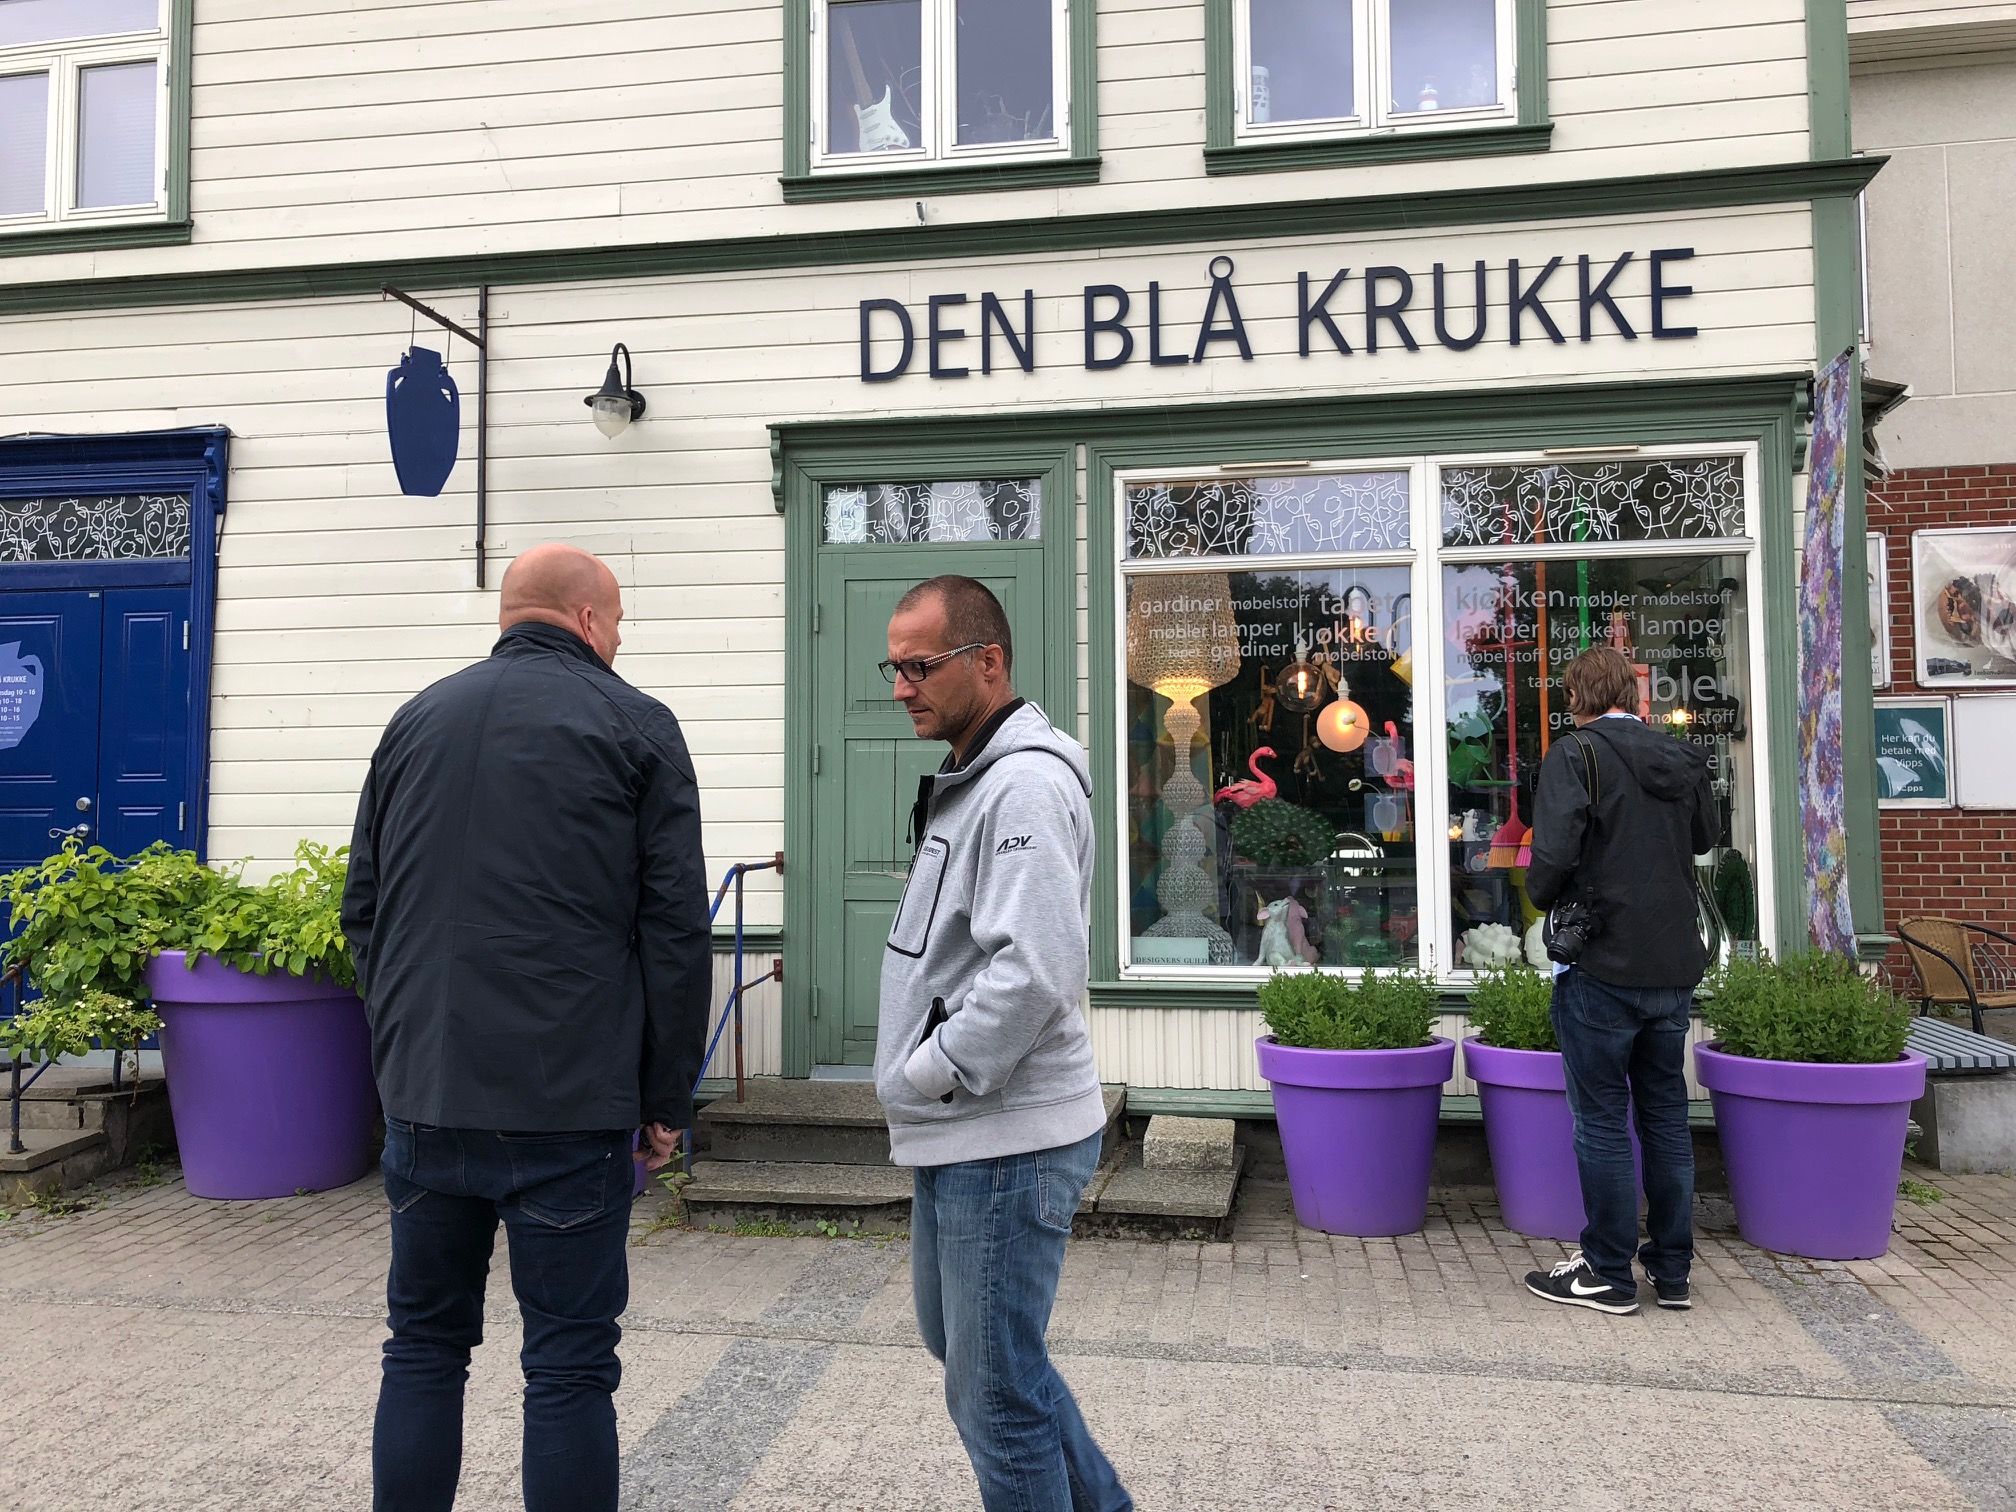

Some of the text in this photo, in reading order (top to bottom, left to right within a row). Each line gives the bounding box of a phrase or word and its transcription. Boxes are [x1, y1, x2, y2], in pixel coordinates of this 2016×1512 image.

[860, 247, 1698, 383] DEN BLÅ KRUKKE
[1140, 595, 1223, 618] gardiner
[1229, 594, 1310, 611] møbelstoff
[1456, 585, 1733, 614] kjøkken møbler møbelstoff
[1601, 611, 1636, 624] taet
[1149, 624, 1209, 640] møbler
[1213, 619, 1283, 641] lamper
[1456, 615, 1730, 643] lamper kjøkken lamper
[1211, 641, 1289, 661] gardiner
[1457, 648, 1545, 663] møbelstoff
[1646, 644, 1732, 659] møbelsto
[1528, 675, 1563, 692] tape
[1652, 665, 1734, 702] bler
[1685, 731, 1735, 746] tapet
[1881, 734, 1936, 743] Her kan du
[1881, 746, 1912, 755] betale
[1136, 956, 1208, 965] DESIGNERS GUILD
